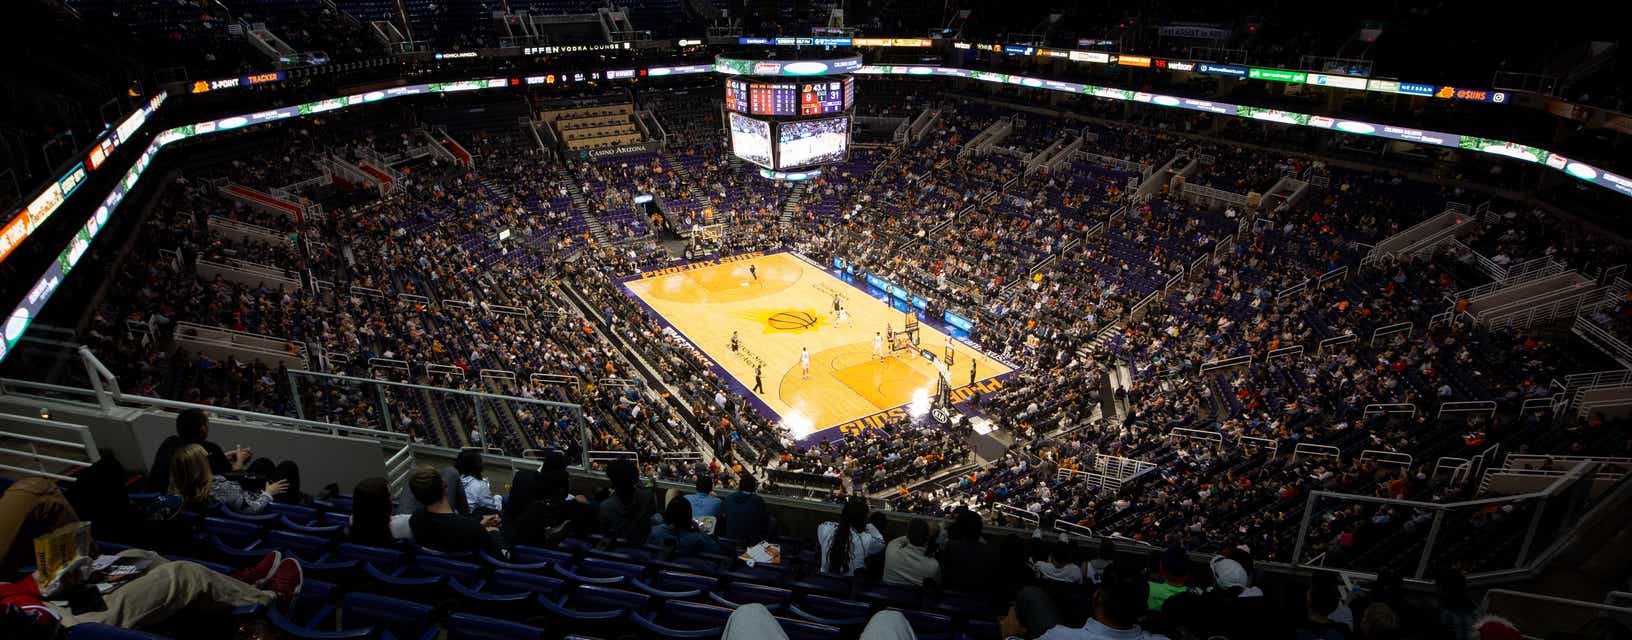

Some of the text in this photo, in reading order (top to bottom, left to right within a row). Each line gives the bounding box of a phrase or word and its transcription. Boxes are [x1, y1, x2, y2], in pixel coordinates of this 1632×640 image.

[524, 46, 559, 55] EFFEN
[589, 43, 619, 51] LOUNGE
[1168, 62, 1192, 71] verizon
[211, 73, 278, 90] 3-POINT TRACKER
[805, 93, 812, 102] 9
[830, 91, 839, 100] 31
[1456, 89, 1486, 101] @SUNS
[640, 251, 765, 279] PHOENIX SUNS
